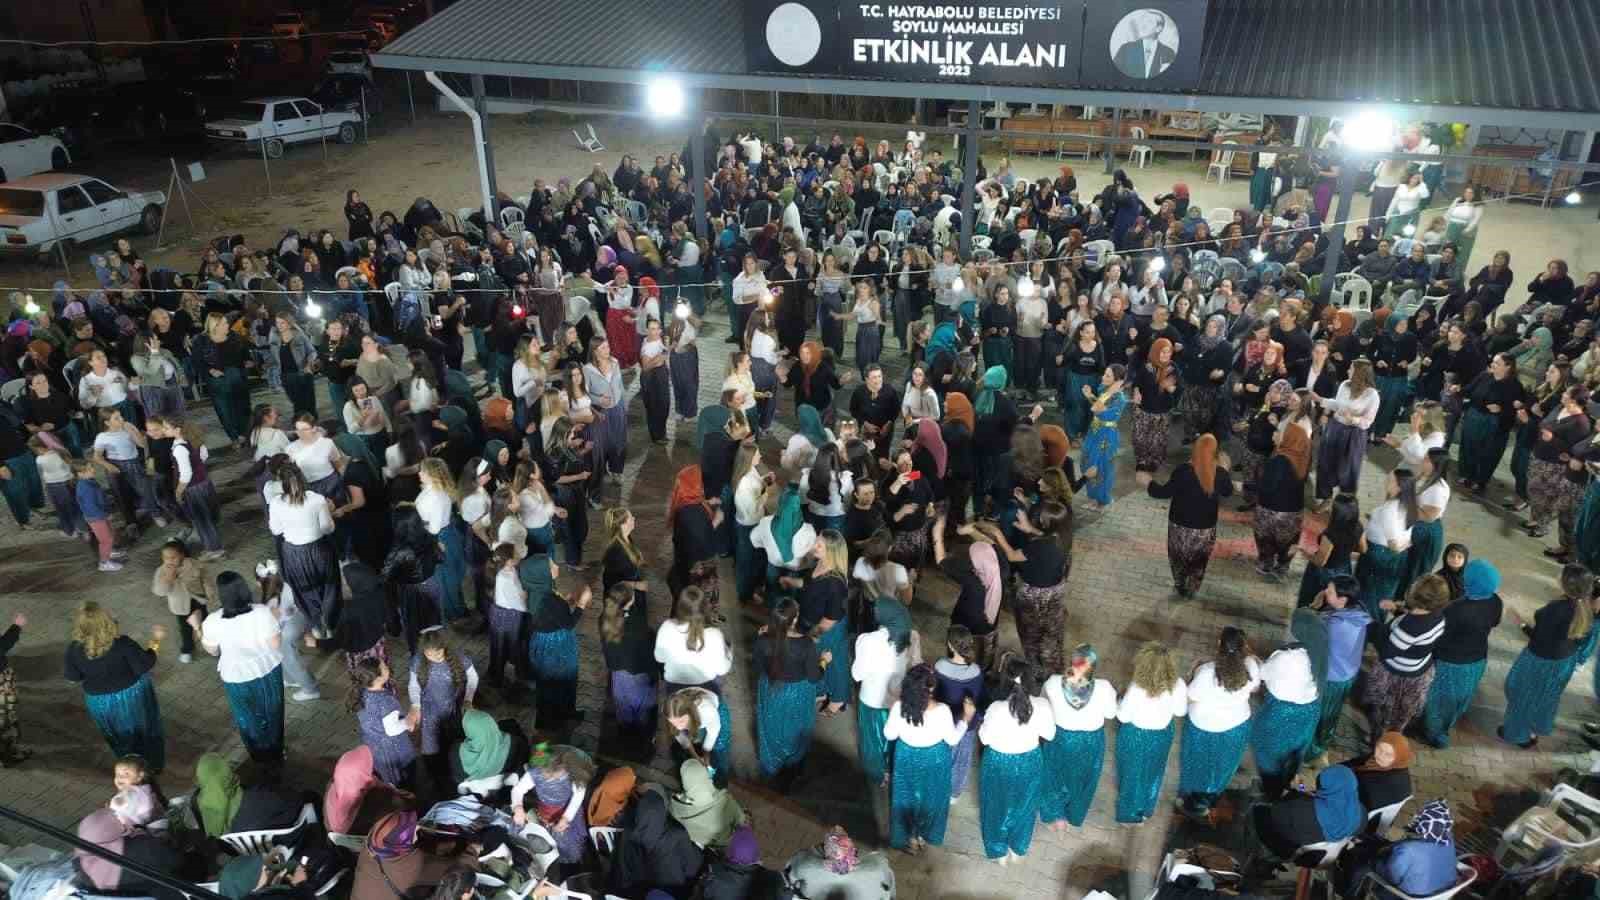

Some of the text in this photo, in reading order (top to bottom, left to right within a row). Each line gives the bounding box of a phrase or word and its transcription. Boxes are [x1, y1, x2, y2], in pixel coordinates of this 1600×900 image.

[860, 5, 1061, 20] T.C. HAYRABOLU BELEDİYESİ
[893, 20, 1024, 35] SOYLU MAHALLESİ
[853, 33, 1067, 68] ETKİNLİK ALANI
[939, 65, 971, 76] 2023
